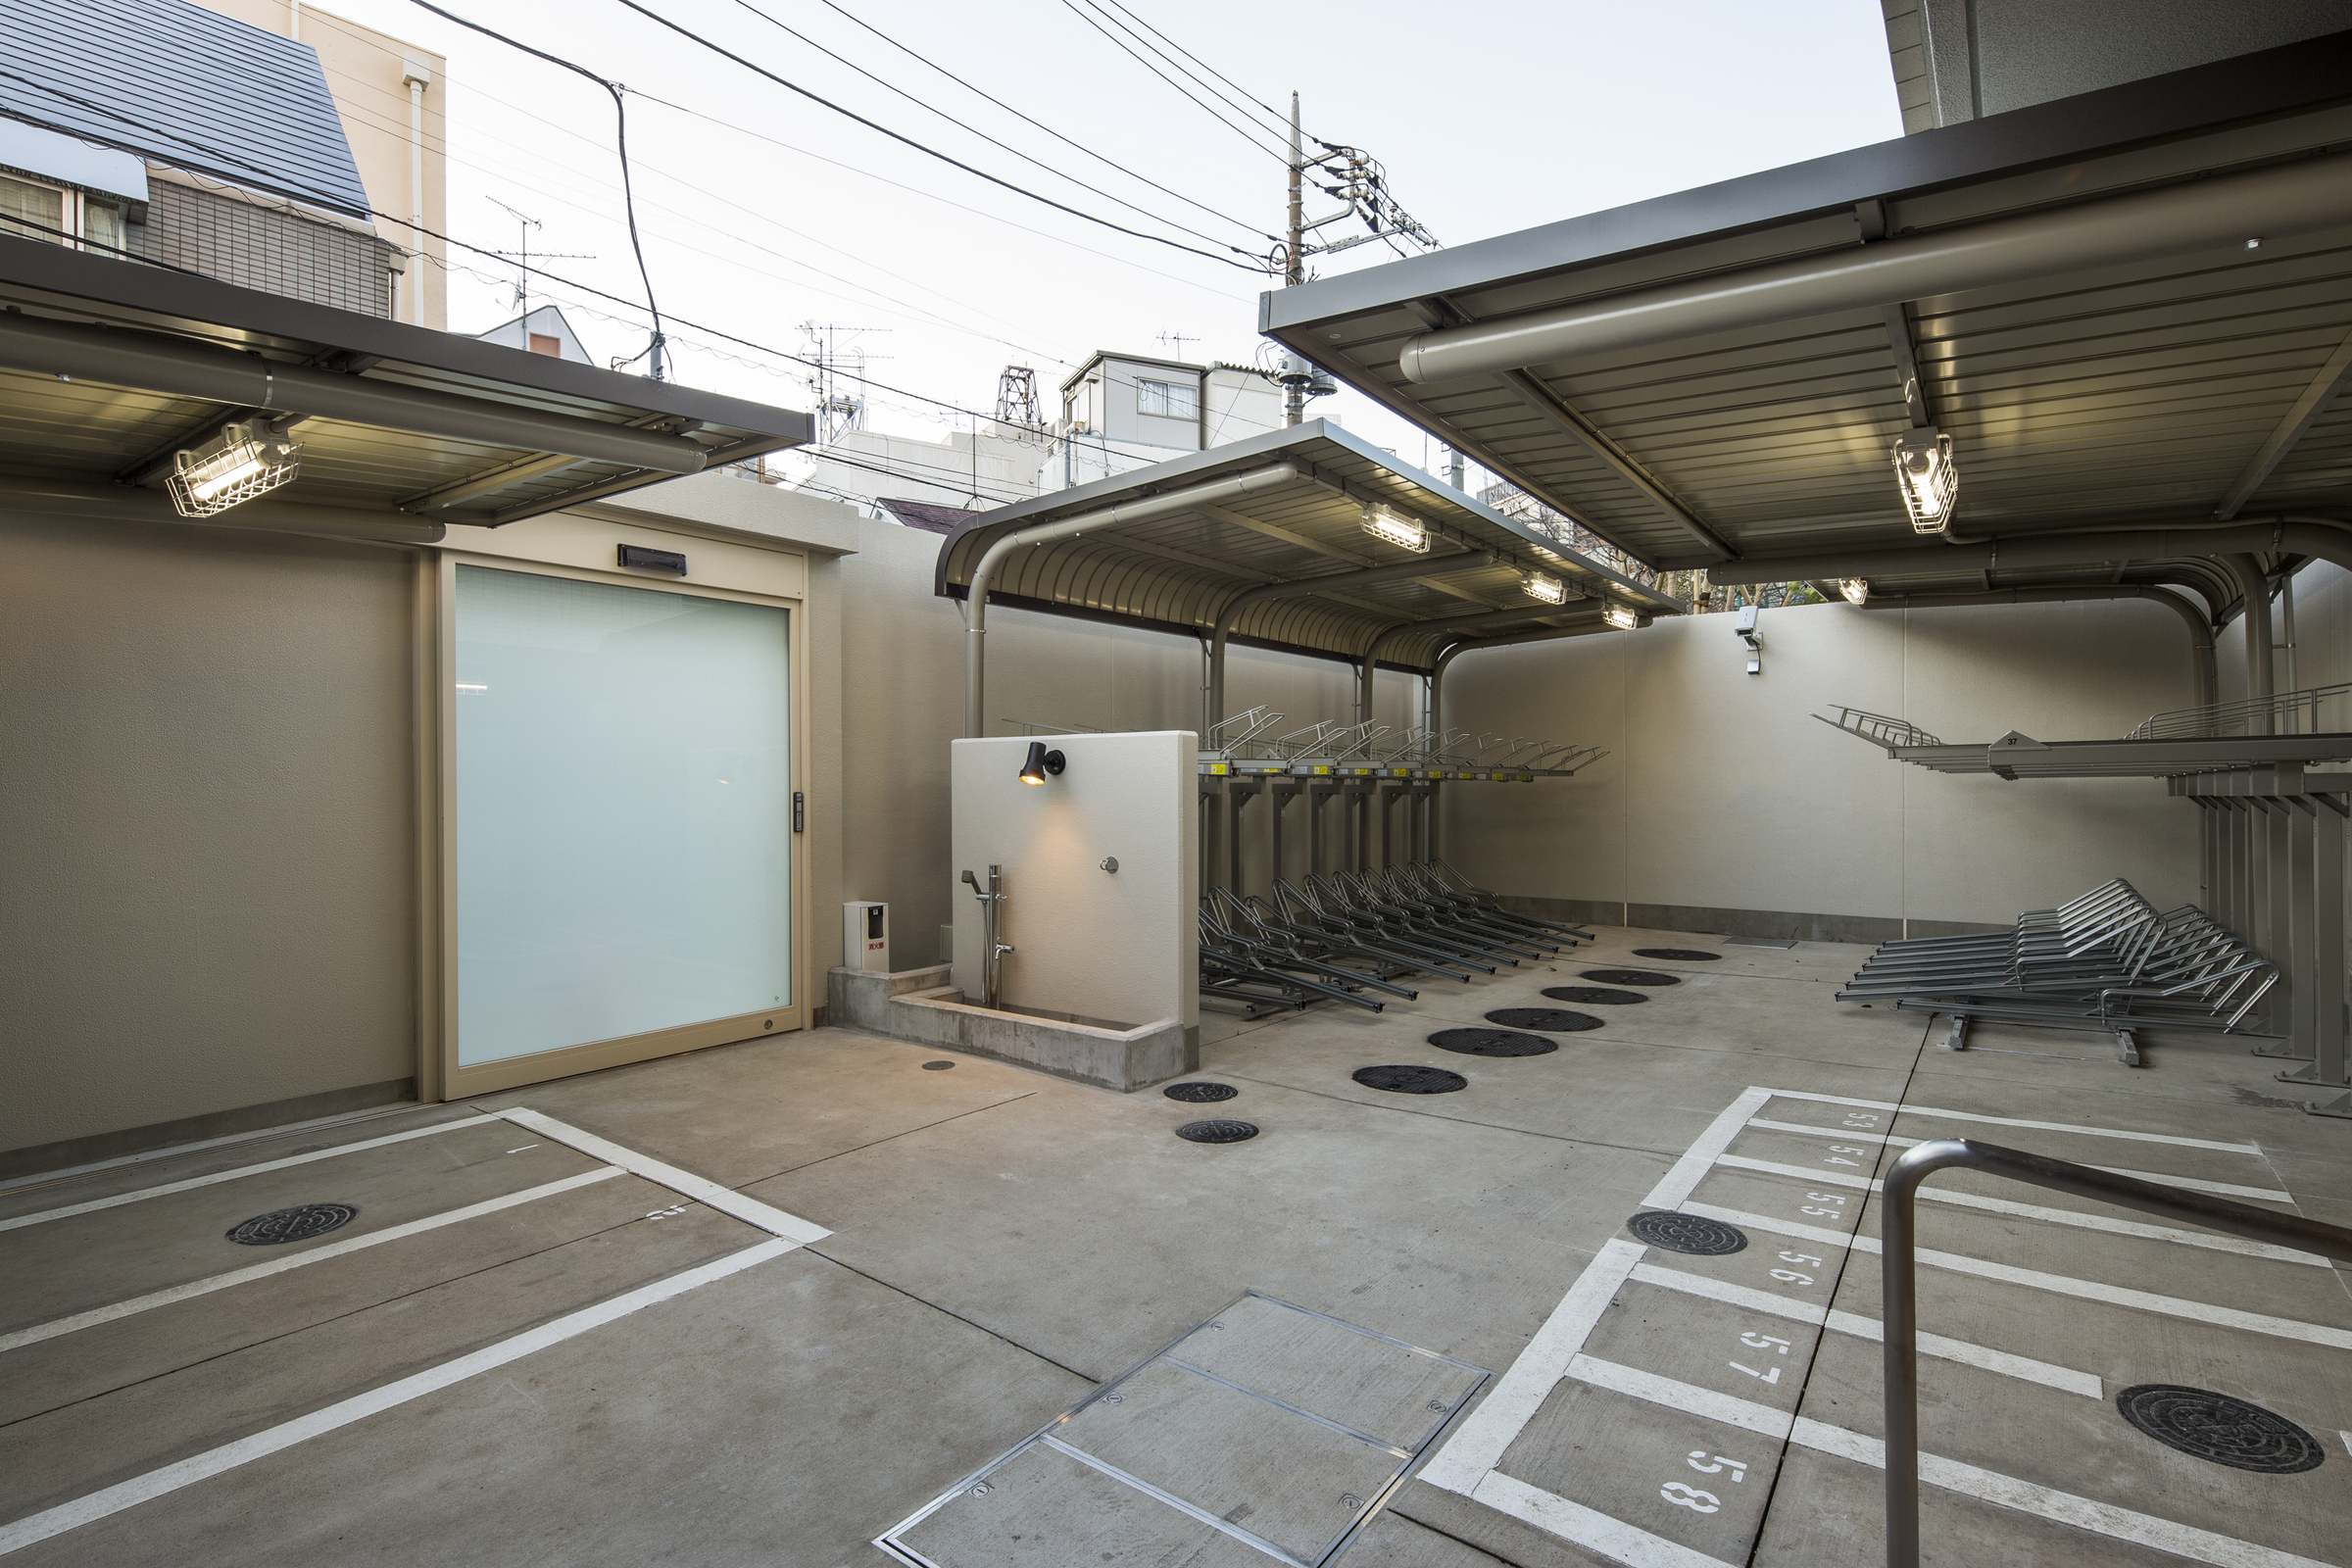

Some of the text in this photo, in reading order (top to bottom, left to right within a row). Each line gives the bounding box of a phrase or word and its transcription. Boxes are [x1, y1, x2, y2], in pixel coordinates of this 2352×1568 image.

[868, 942, 884, 951] 消火器
[1842, 1112, 1879, 1128] 53
[1824, 1146, 1864, 1167] 54
[646, 1204, 686, 1220] 2
[1800, 1192, 1845, 1219] 55
[1769, 1250, 1822, 1286] 56
[1729, 1331, 1790, 1385] 57
[1660, 1450, 1747, 1513] 58
